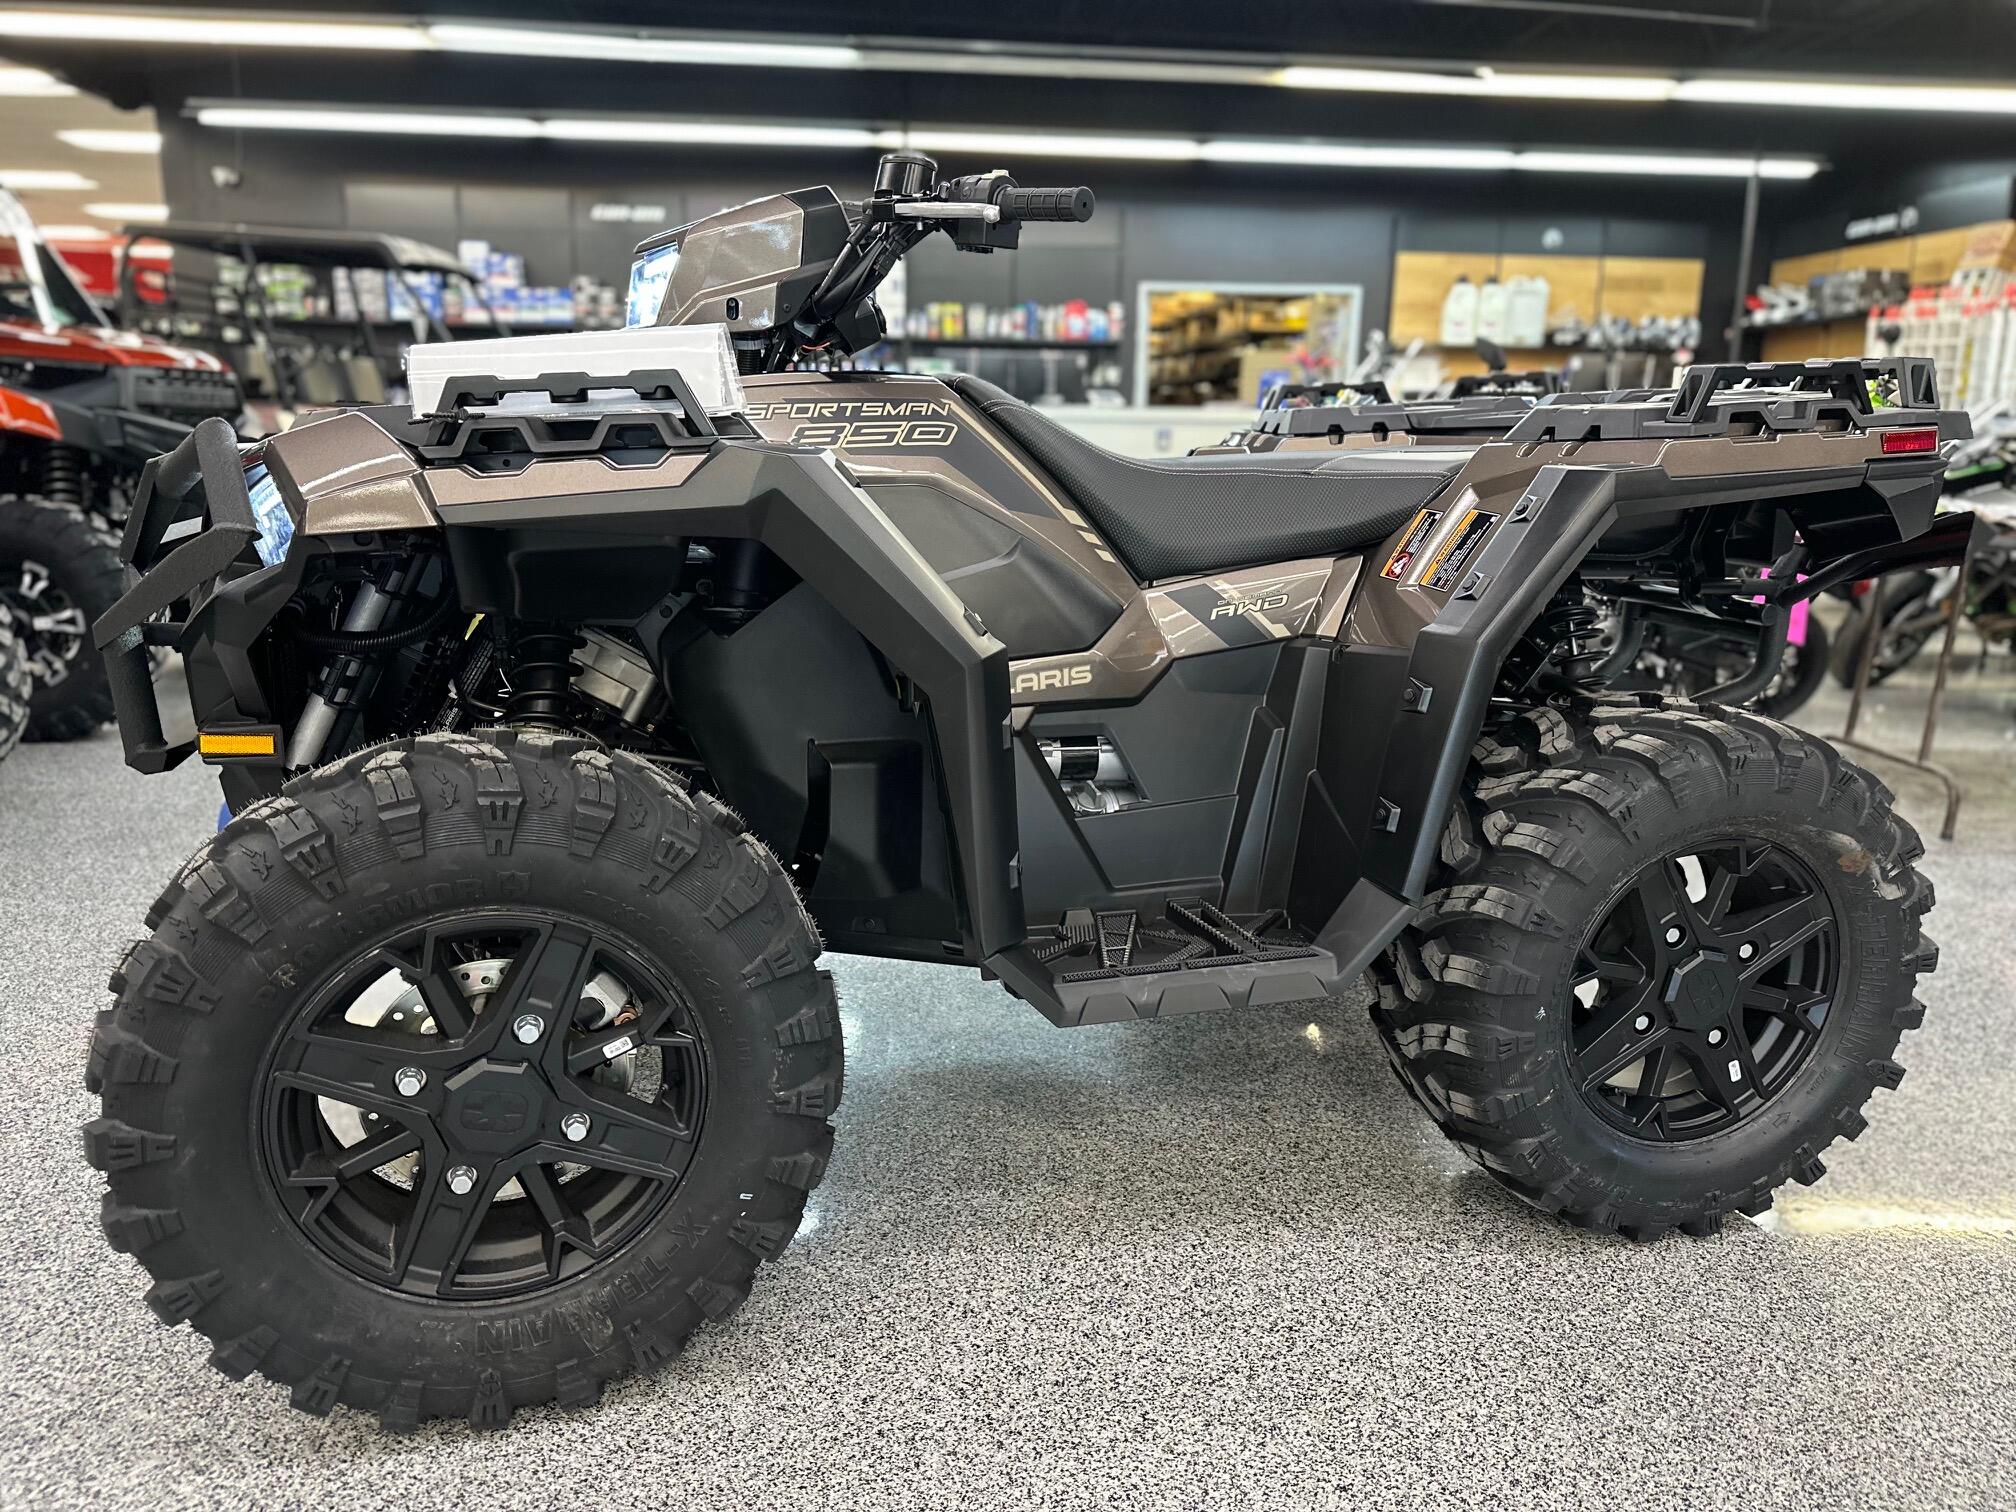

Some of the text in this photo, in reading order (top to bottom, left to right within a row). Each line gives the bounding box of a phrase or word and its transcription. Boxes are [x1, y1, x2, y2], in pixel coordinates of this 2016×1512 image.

[744, 402, 950, 419] SPORTSMAN
[789, 421, 959, 449] 850
[1439, 527, 1464, 562] WARNING
[1209, 594, 1290, 620] AWD
[1010, 665, 1093, 694] ARIS
